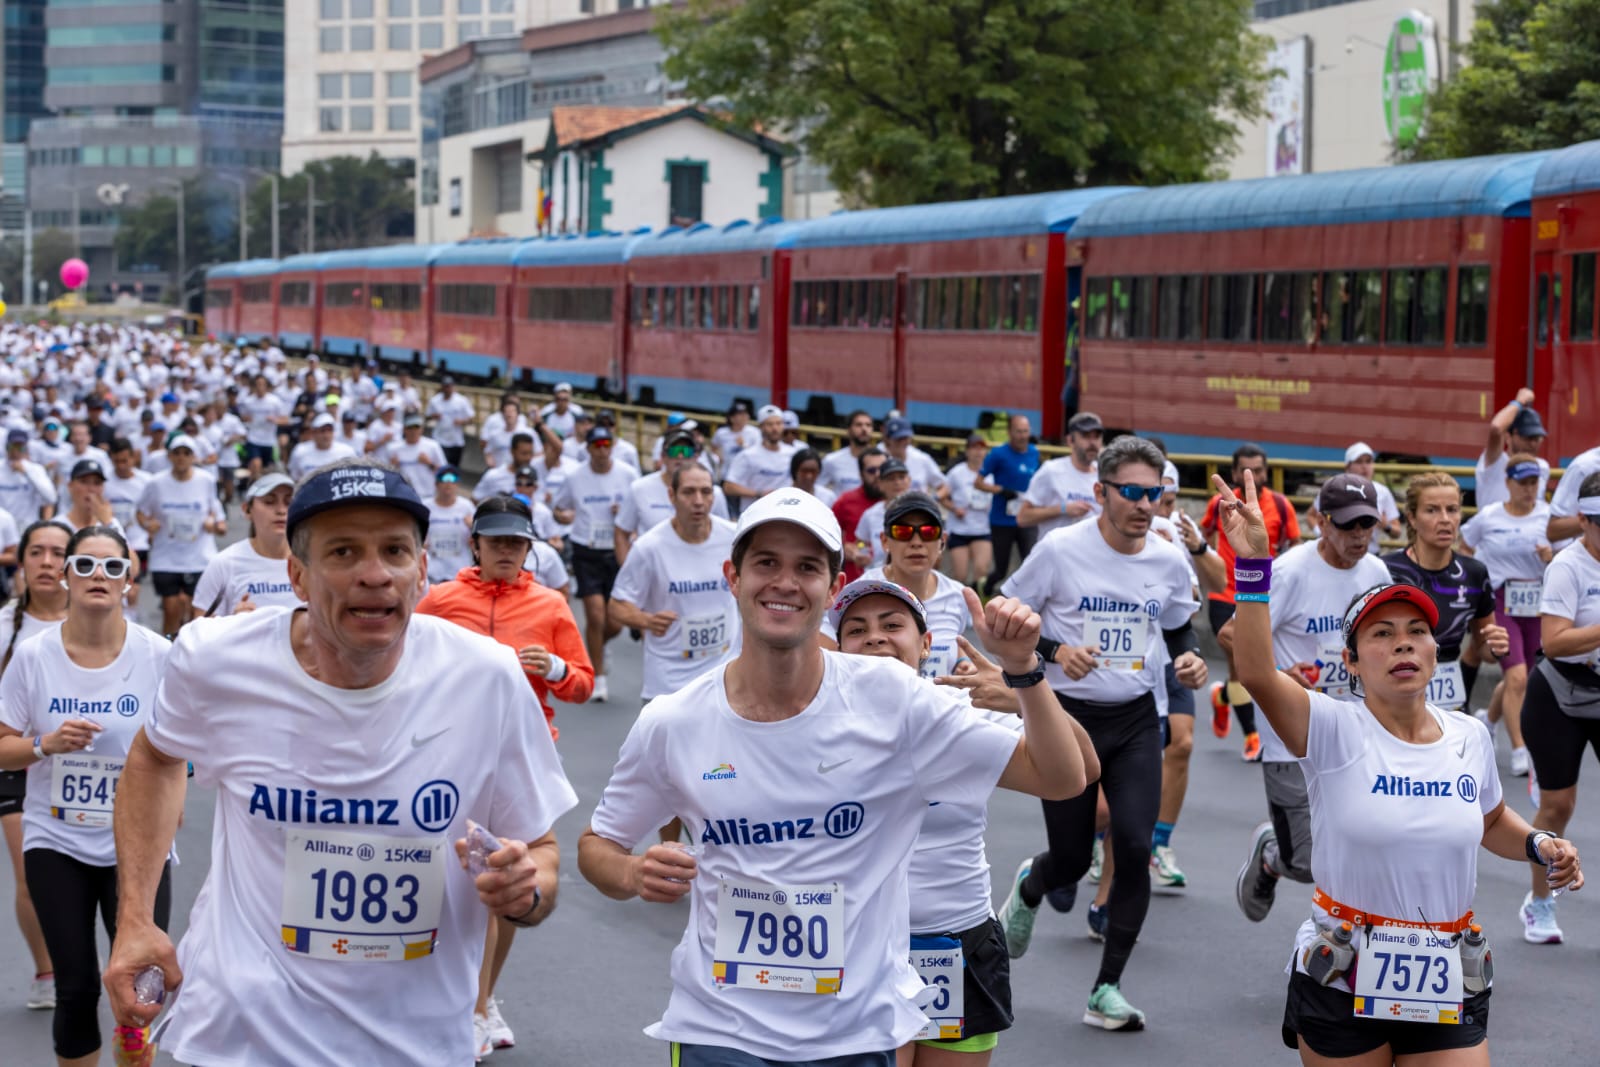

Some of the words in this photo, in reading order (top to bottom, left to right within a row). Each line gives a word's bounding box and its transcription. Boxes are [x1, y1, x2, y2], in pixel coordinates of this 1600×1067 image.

[331, 469, 369, 480] Allianz
[331, 481, 368, 500] 15K
[669, 580, 718, 594] Allianz
[1078, 596, 1140, 612] Allianz
[689, 623, 725, 647] 8827
[1099, 628, 1132, 652] 976
[1425, 678, 1455, 701] 173
[48, 698, 112, 713] Allianz
[62, 760, 88, 768] Allianz
[703, 771, 737, 780] Electrolit
[1371, 774, 1452, 797] Allianz
[249, 783, 399, 826] Allianz
[701, 818, 815, 846] Allianz
[305, 840, 353, 856] Allianz
[384, 848, 416, 863] 15K
[311, 868, 420, 924] 1983
[732, 887, 771, 902] Allianz
[795, 892, 819, 905] 15K
[735, 909, 828, 960] 7980
[1371, 932, 1406, 944] Allianz
[920, 957, 942, 968] 15K
[1373, 952, 1449, 994] 7573
